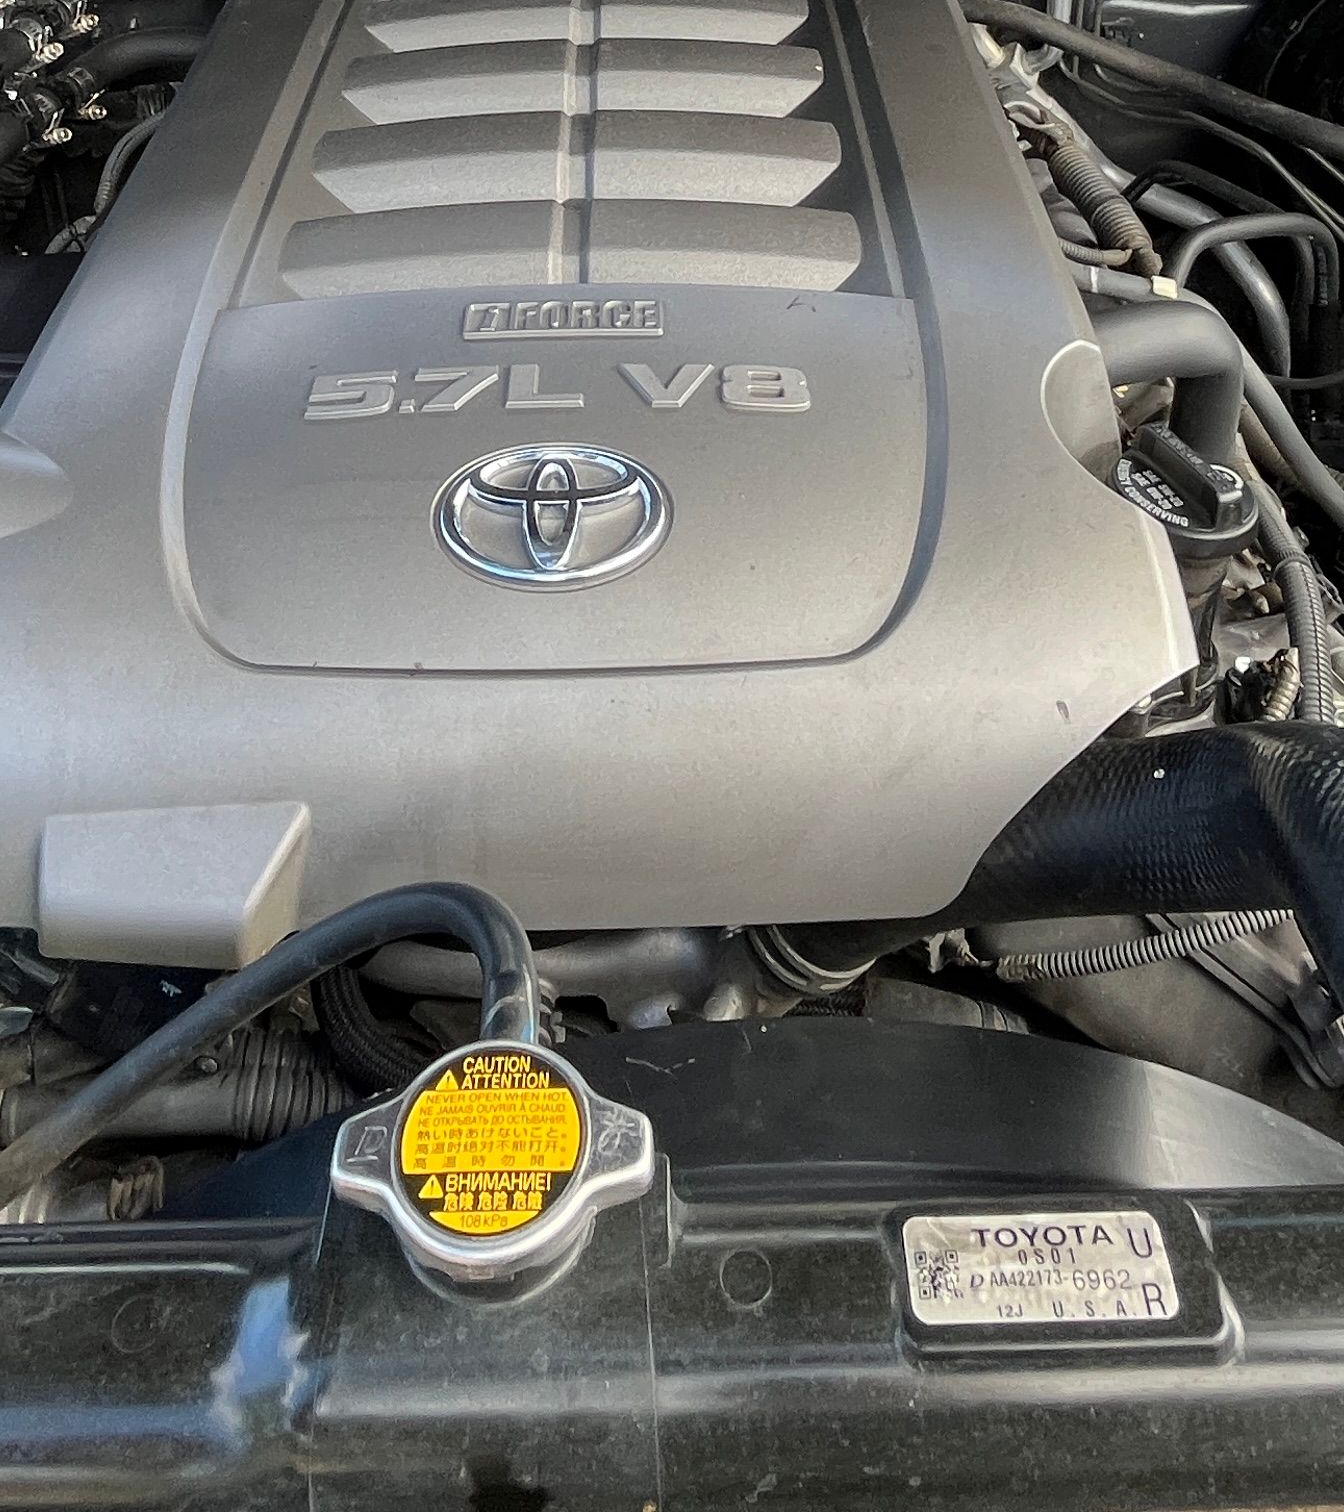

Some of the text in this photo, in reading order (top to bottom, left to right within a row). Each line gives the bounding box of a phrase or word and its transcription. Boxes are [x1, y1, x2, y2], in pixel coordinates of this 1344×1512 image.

[304, 364, 811, 419] 5.7L V8
[462, 1056, 532, 1074] CAUTION
[461, 1072, 550, 1089] ATTENTION
[426, 1094, 466, 1105] NEVER
[469, 1093, 501, 1103] OPEN
[505, 1092, 540, 1103] WHEN
[419, 1106, 433, 1116] NE
[436, 1104, 474, 1115] JAMAIS
[476, 1104, 517, 1113] OUVRIR
[418, 1117, 429, 1128] НЕ
[445, 1172, 552, 1192] ВНИМАНИЕ!
[971, 1225, 1153, 1259] TOYOTA U
[997, 1304, 1024, 1317] 12J
[1142, 1282, 1167, 1317] R
